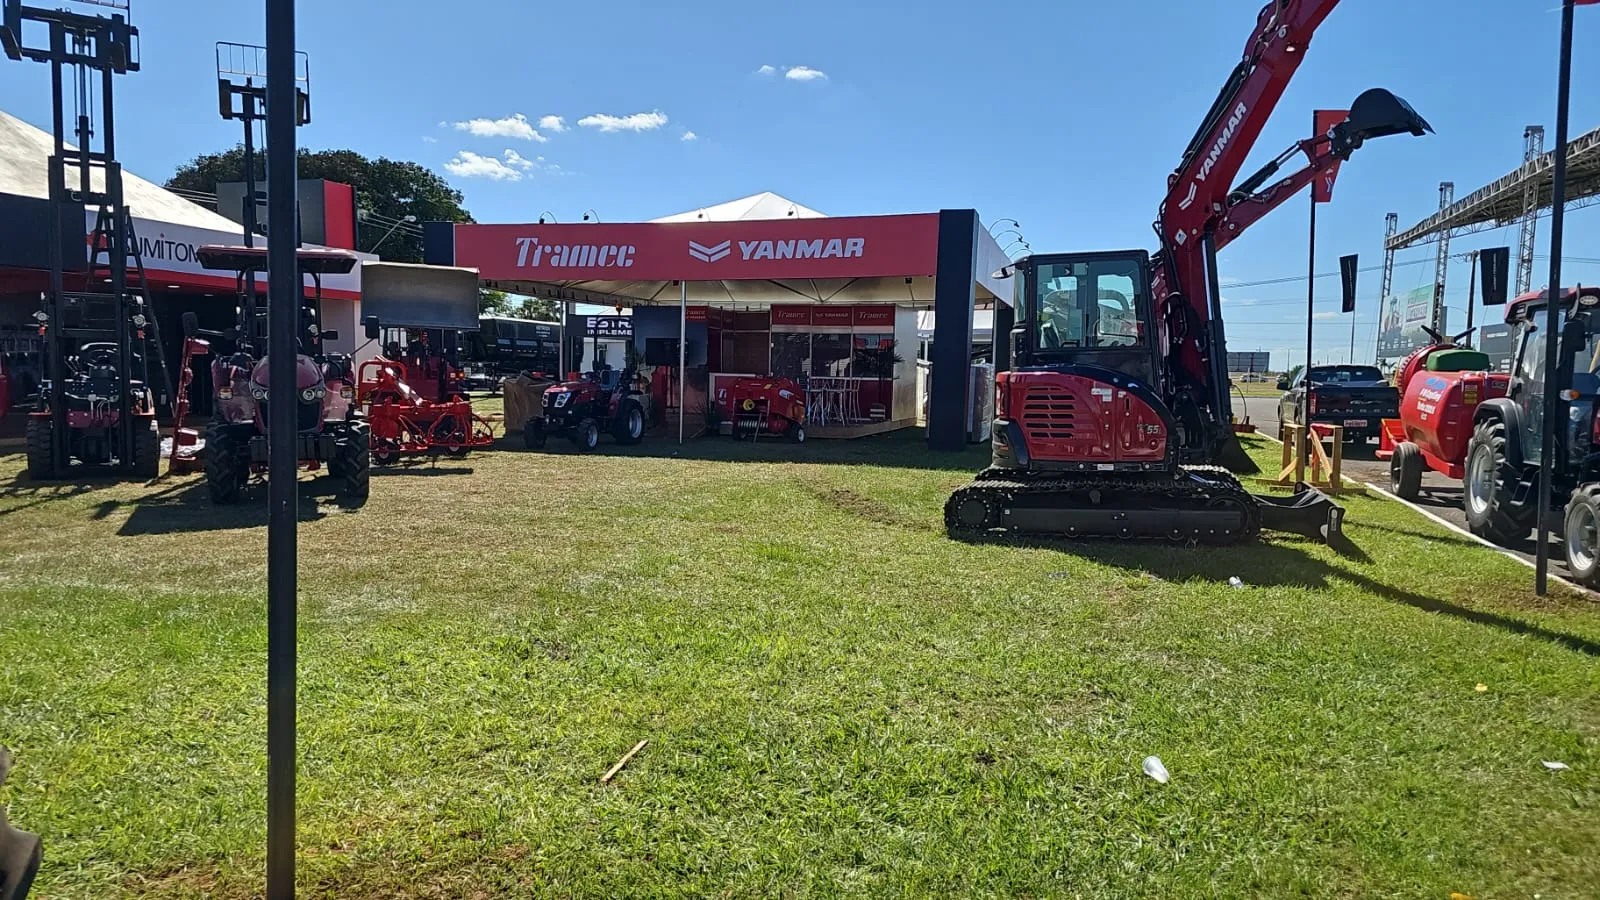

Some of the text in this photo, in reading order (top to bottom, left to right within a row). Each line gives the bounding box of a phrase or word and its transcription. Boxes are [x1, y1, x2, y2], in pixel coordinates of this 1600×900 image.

[1195, 102, 1247, 181] YANMAR
[126, 233, 199, 263] UMITOM
[738, 238, 865, 261] YANMAR
